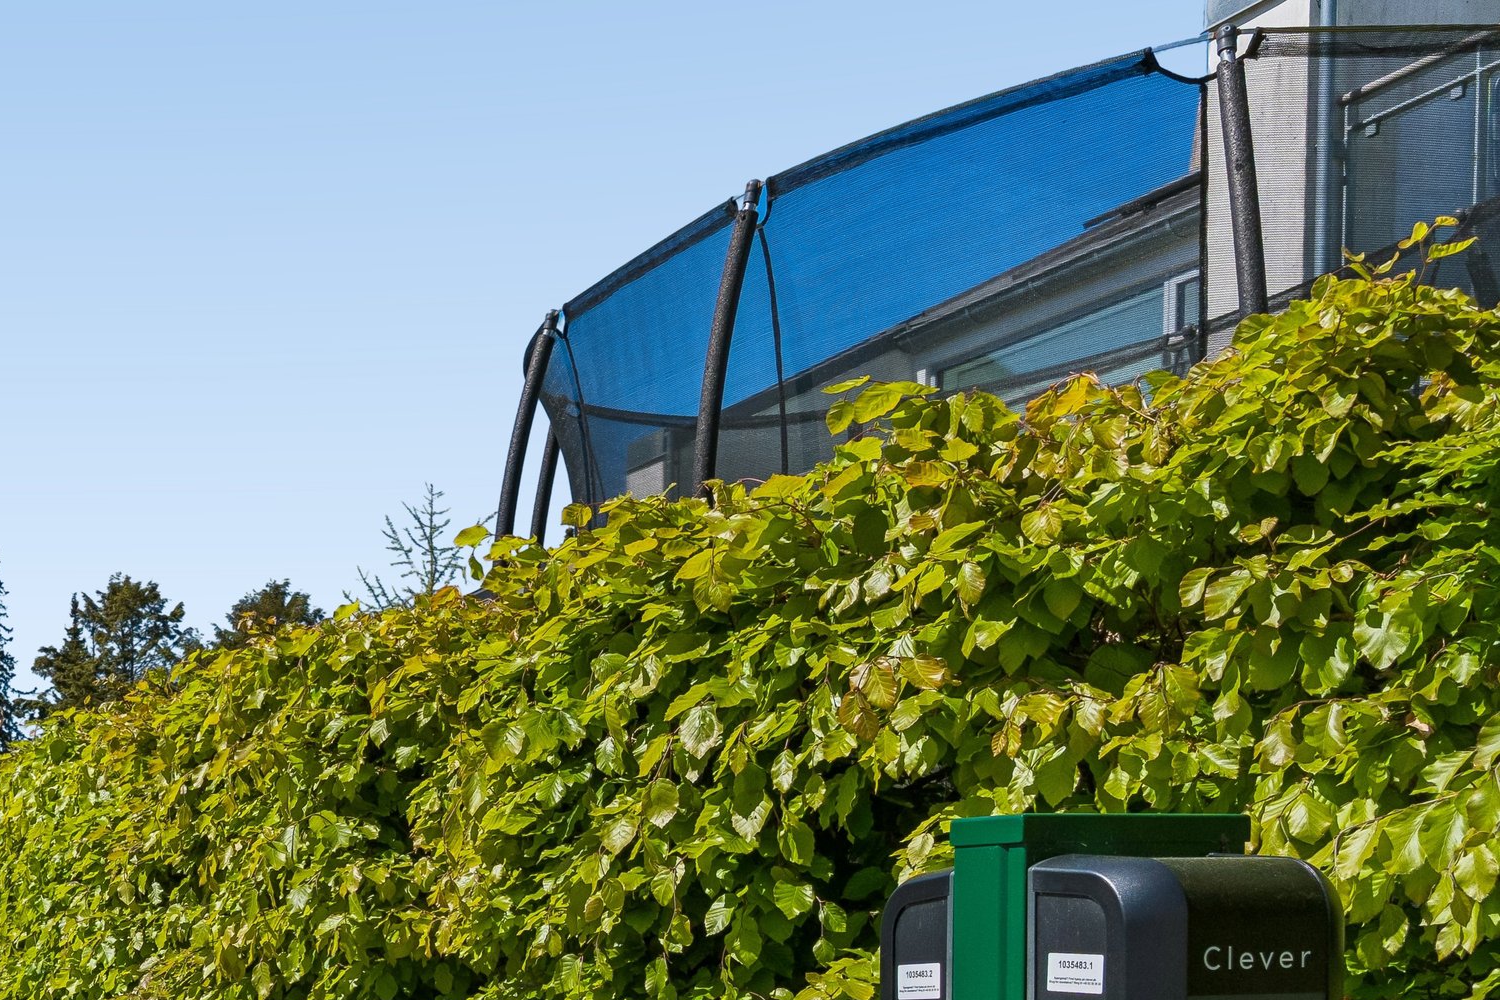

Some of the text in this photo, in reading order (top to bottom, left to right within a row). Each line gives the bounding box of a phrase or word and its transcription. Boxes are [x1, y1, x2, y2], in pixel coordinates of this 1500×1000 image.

[1203, 945, 1312, 971] Clever
[1058, 960, 1093, 970] 1035483.1
[906, 969, 933, 979] 1035483.2
